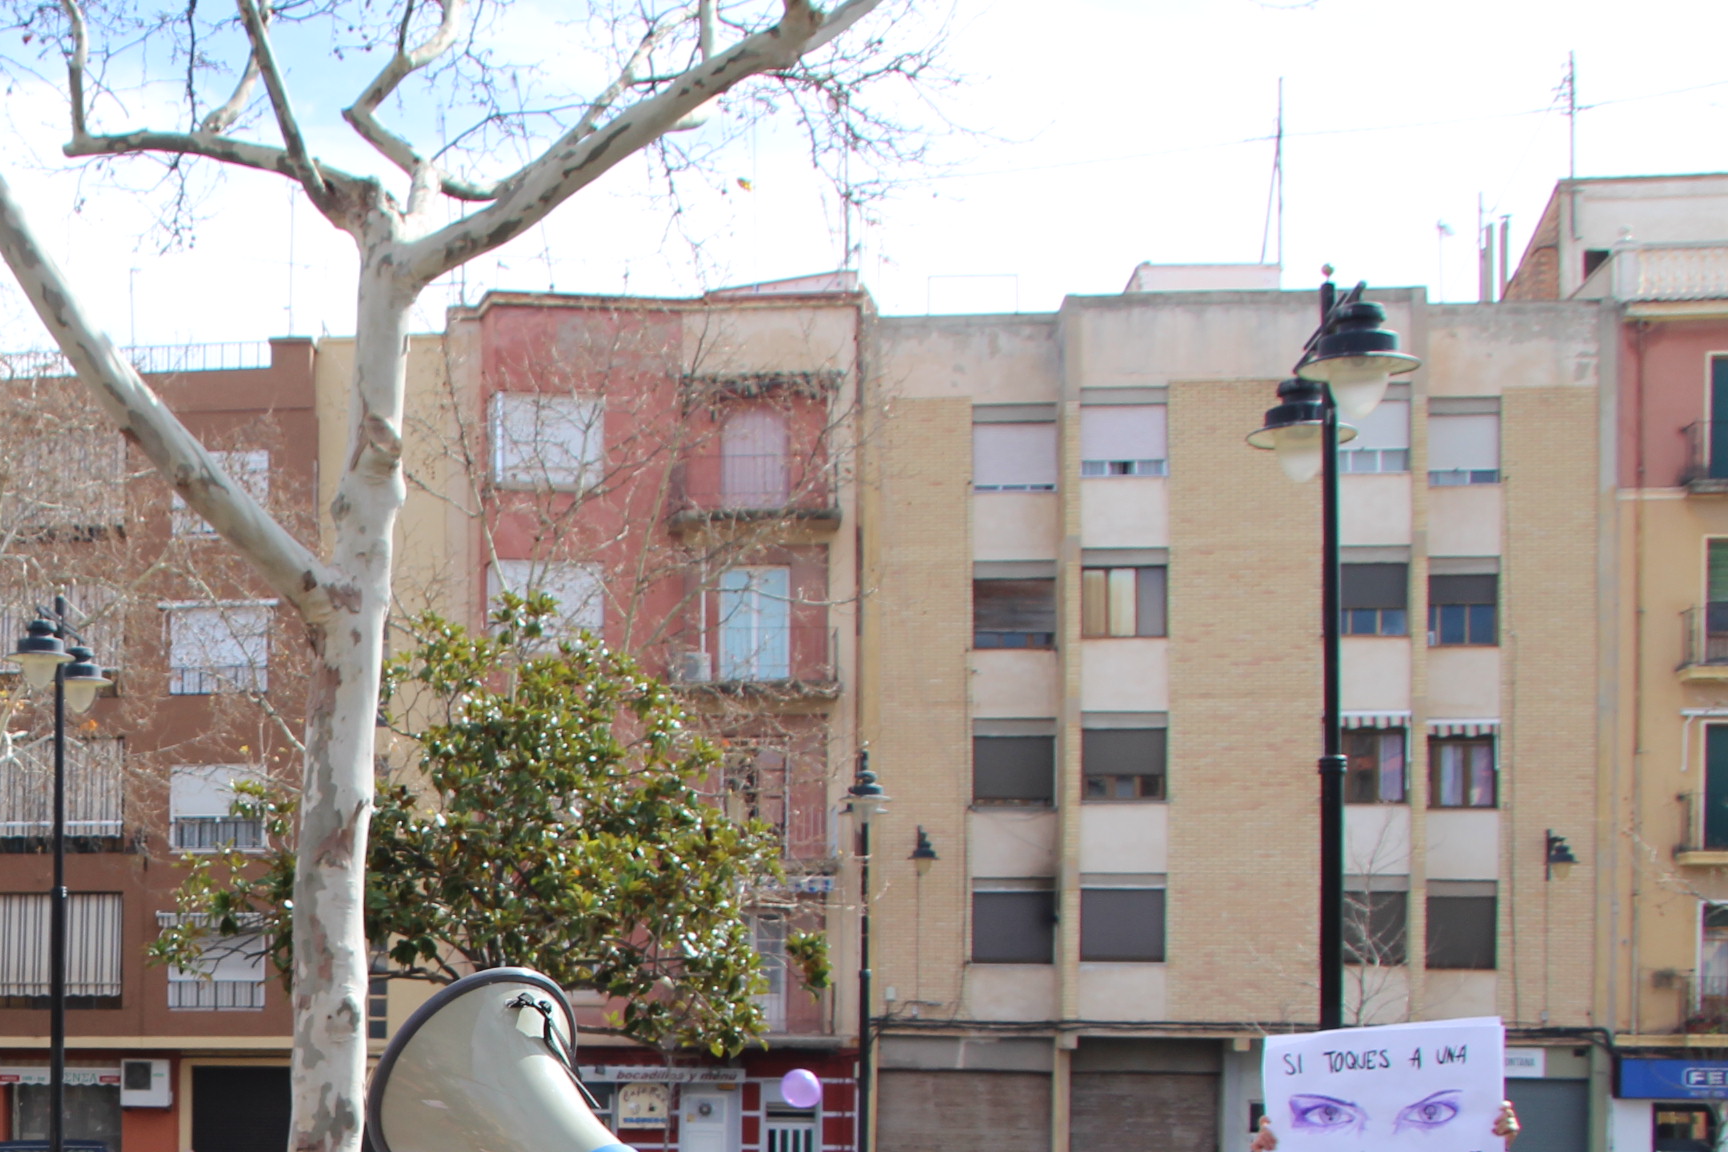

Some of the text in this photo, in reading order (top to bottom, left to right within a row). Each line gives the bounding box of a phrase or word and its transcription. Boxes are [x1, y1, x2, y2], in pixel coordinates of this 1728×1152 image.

[1283, 1044, 1467, 1076] SI TOQUES A UNA
